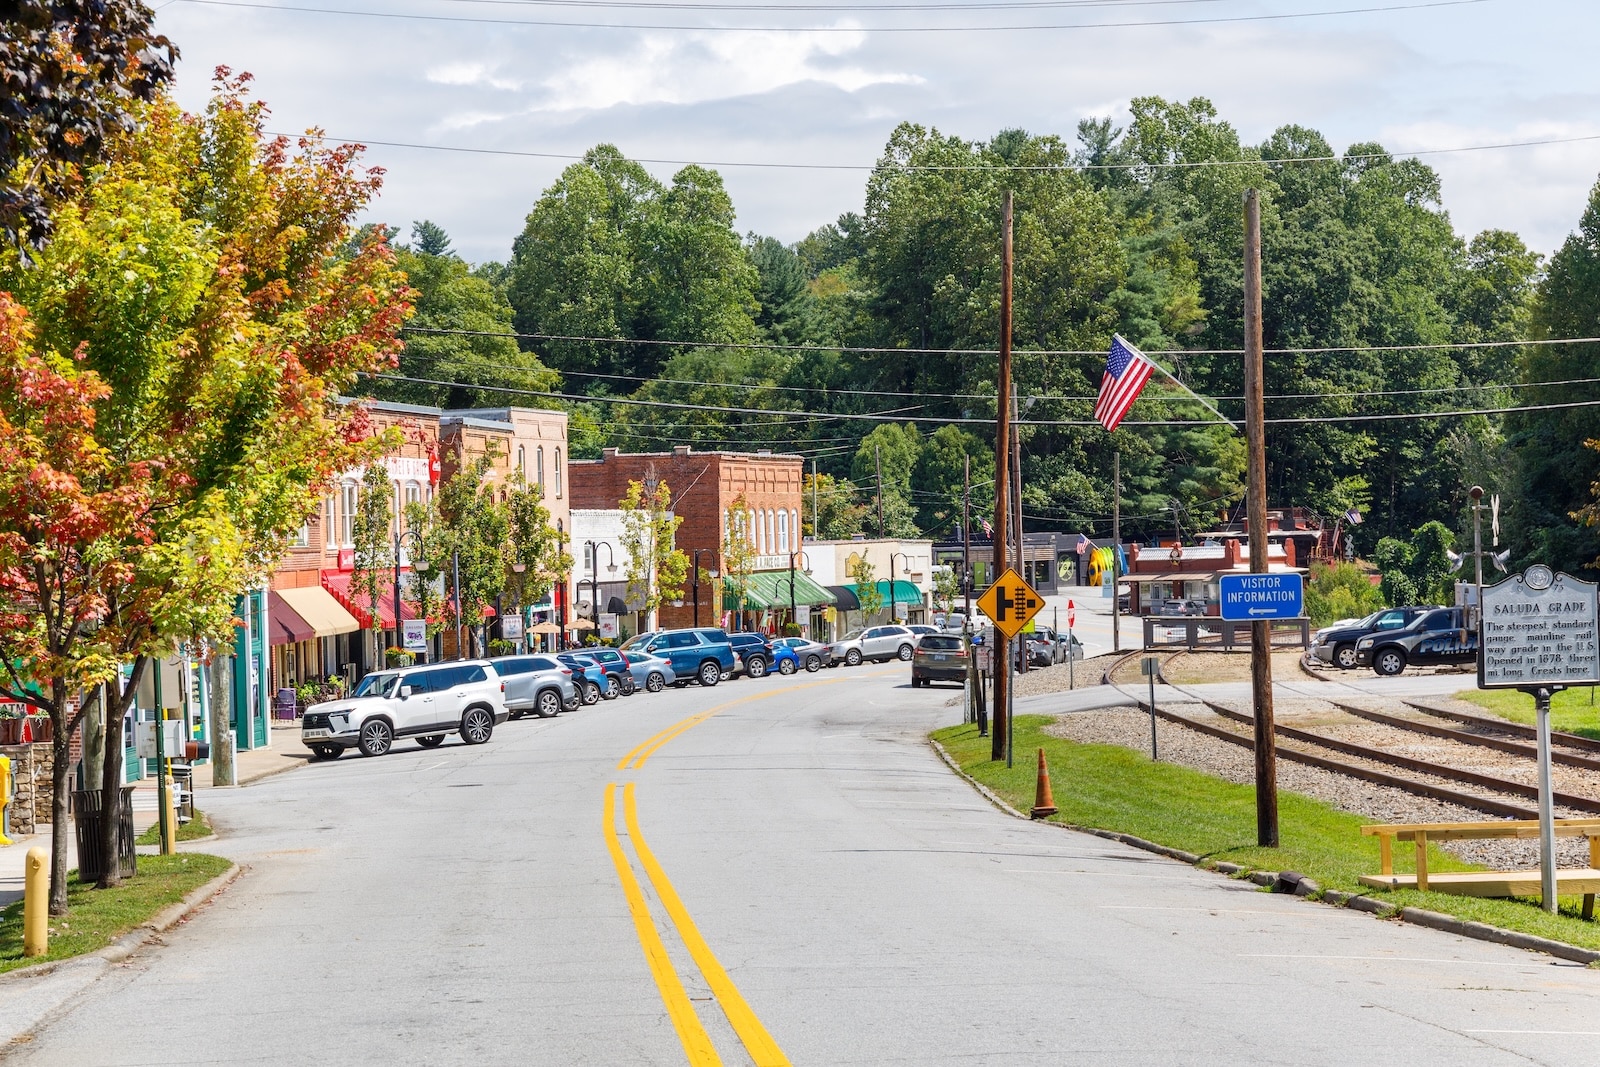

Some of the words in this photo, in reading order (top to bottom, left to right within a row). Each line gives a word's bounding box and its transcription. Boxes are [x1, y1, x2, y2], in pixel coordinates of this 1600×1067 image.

[1241, 577, 1281, 589] VISITOR
[1227, 591, 1295, 603] INFORMATION
[1494, 603, 1541, 614] SALUDA
[1548, 602, 1586, 612] GRADE
[1486, 622, 1504, 631] The
[1553, 619, 1595, 629] standard
[1527, 632, 1566, 641] mainline
[1575, 631, 1595, 640] rail-
[1487, 647, 1506, 655] way
[1511, 644, 1539, 654] grade
[1543, 644, 1551, 652] in
[1557, 643, 1573, 652] the
[1487, 656, 1523, 666] Opened
[1569, 654, 1596, 662] three
[1531, 666, 1561, 675] Crests
[1, 704, 25, 713] ATM
